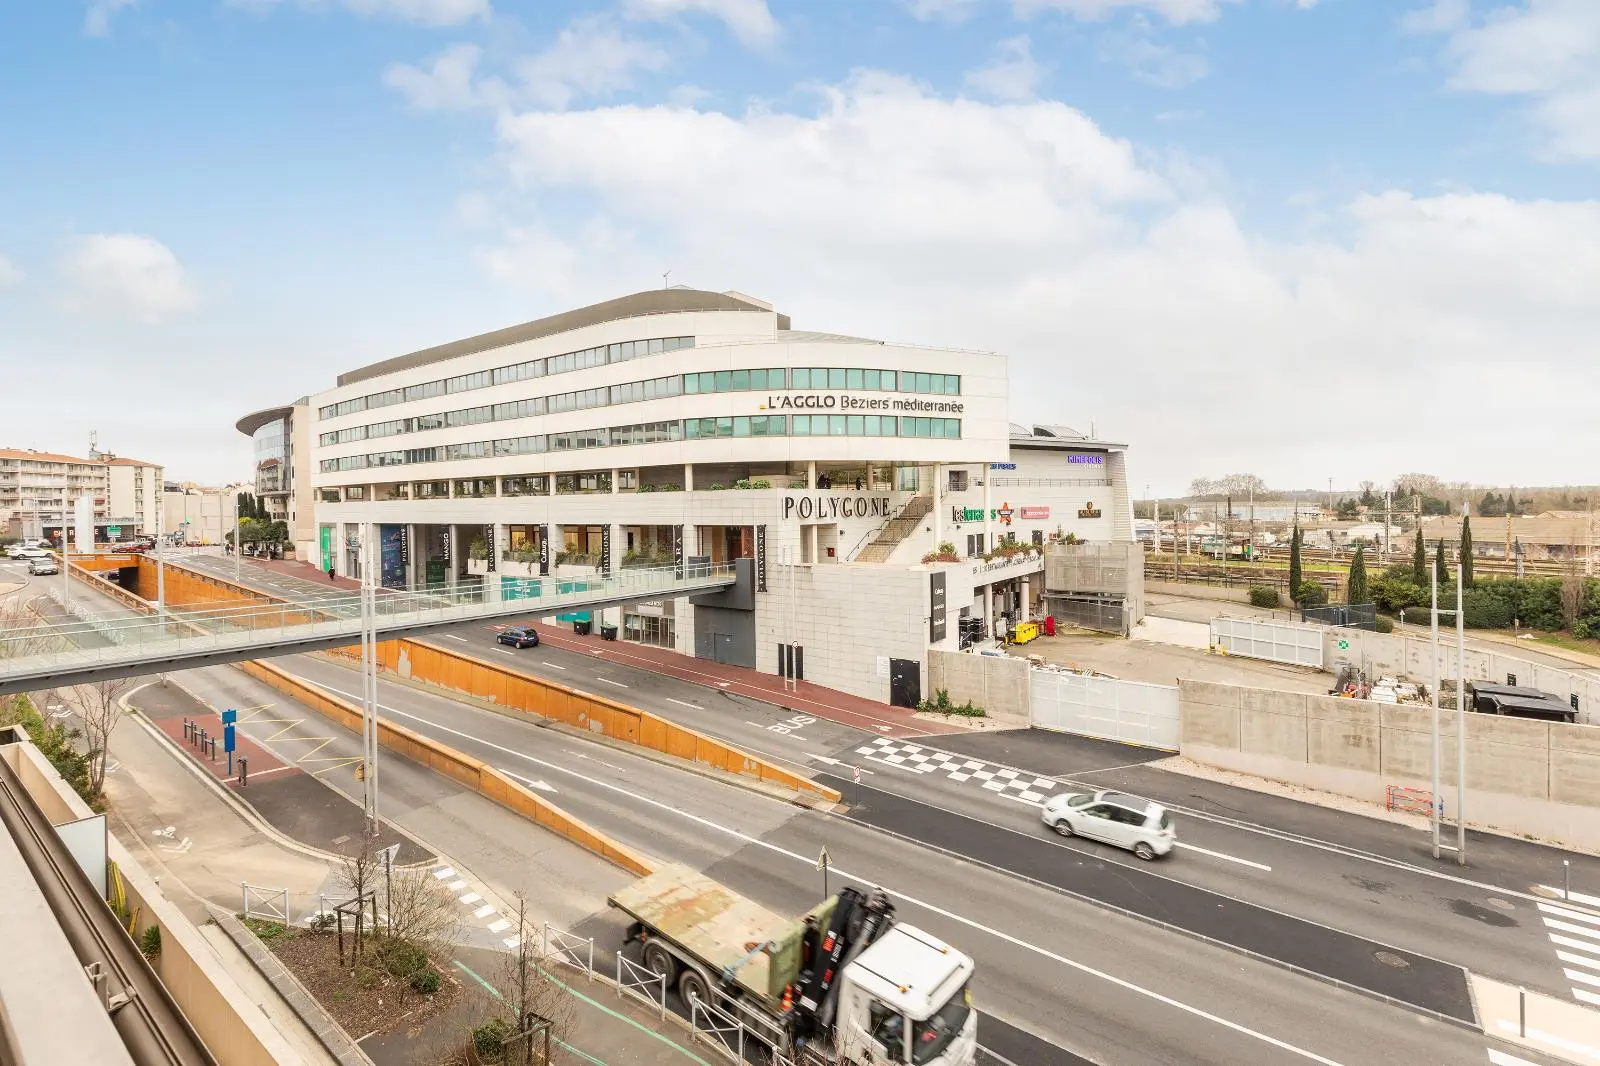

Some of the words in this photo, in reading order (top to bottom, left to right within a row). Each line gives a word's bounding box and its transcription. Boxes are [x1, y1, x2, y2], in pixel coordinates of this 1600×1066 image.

[768, 395, 836, 409] L'AGGLO
[893, 397, 964, 413] méditerranée
[783, 496, 890, 519] POLYGONE
[766, 715, 816, 735] BUS
